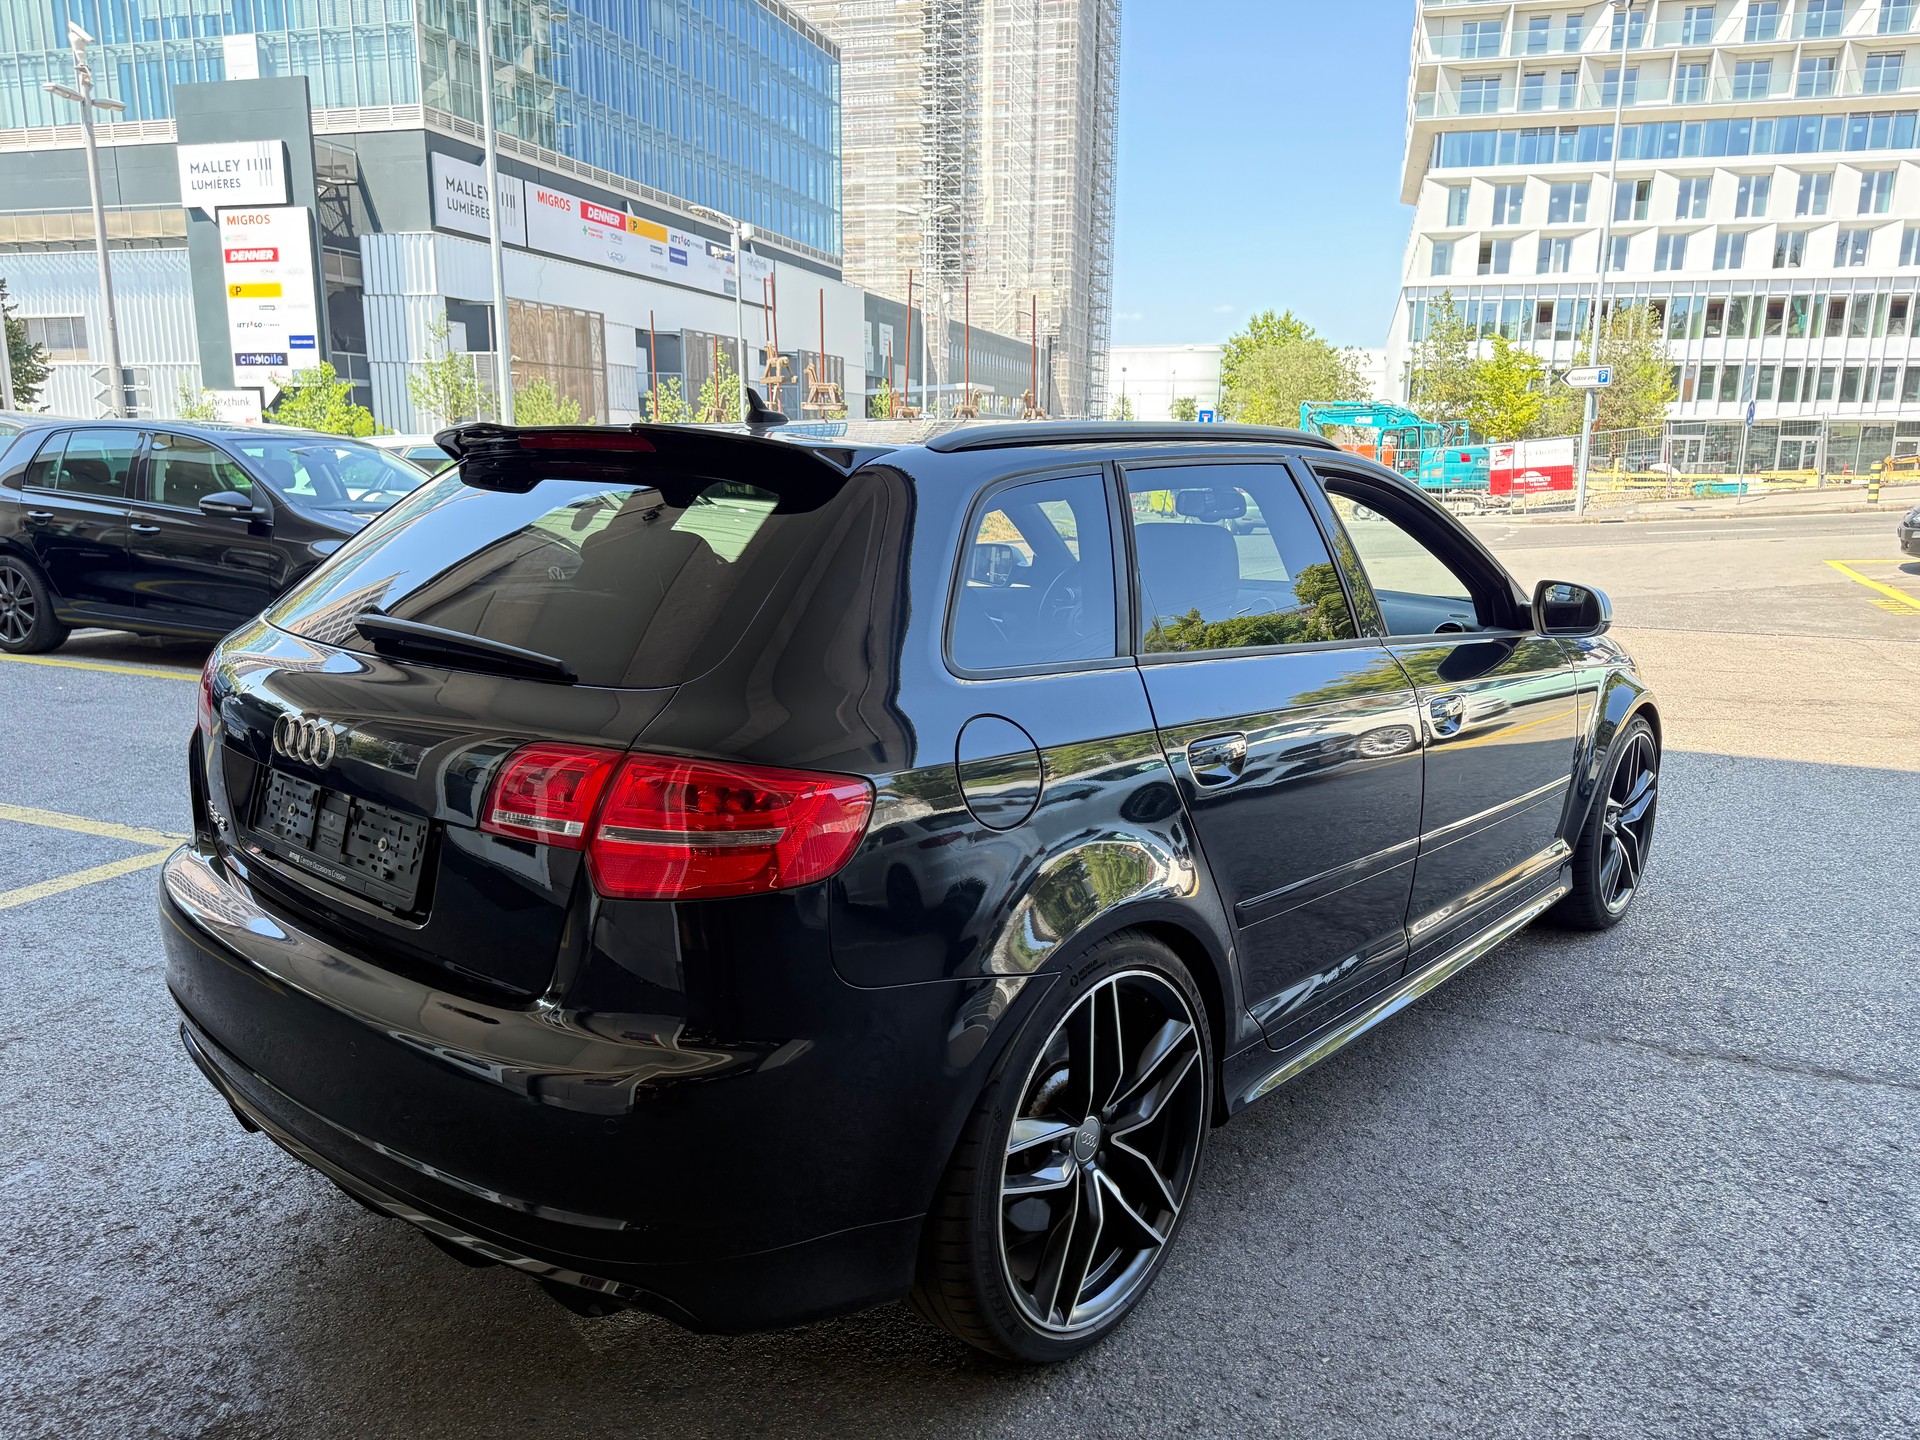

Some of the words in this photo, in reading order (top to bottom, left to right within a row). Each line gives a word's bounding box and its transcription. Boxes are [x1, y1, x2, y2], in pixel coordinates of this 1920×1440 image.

[190, 159, 240, 174] MALLEY
[191, 176, 241, 190] LUMIÈRES
[445, 176, 489, 201] MALLEY
[447, 197, 490, 220] LUMIÈRES
[537, 191, 571, 211] MIGROS
[226, 214, 271, 226] MIGROS
[587, 206, 620, 227] DENNER
[230, 249, 275, 261] DENNER
